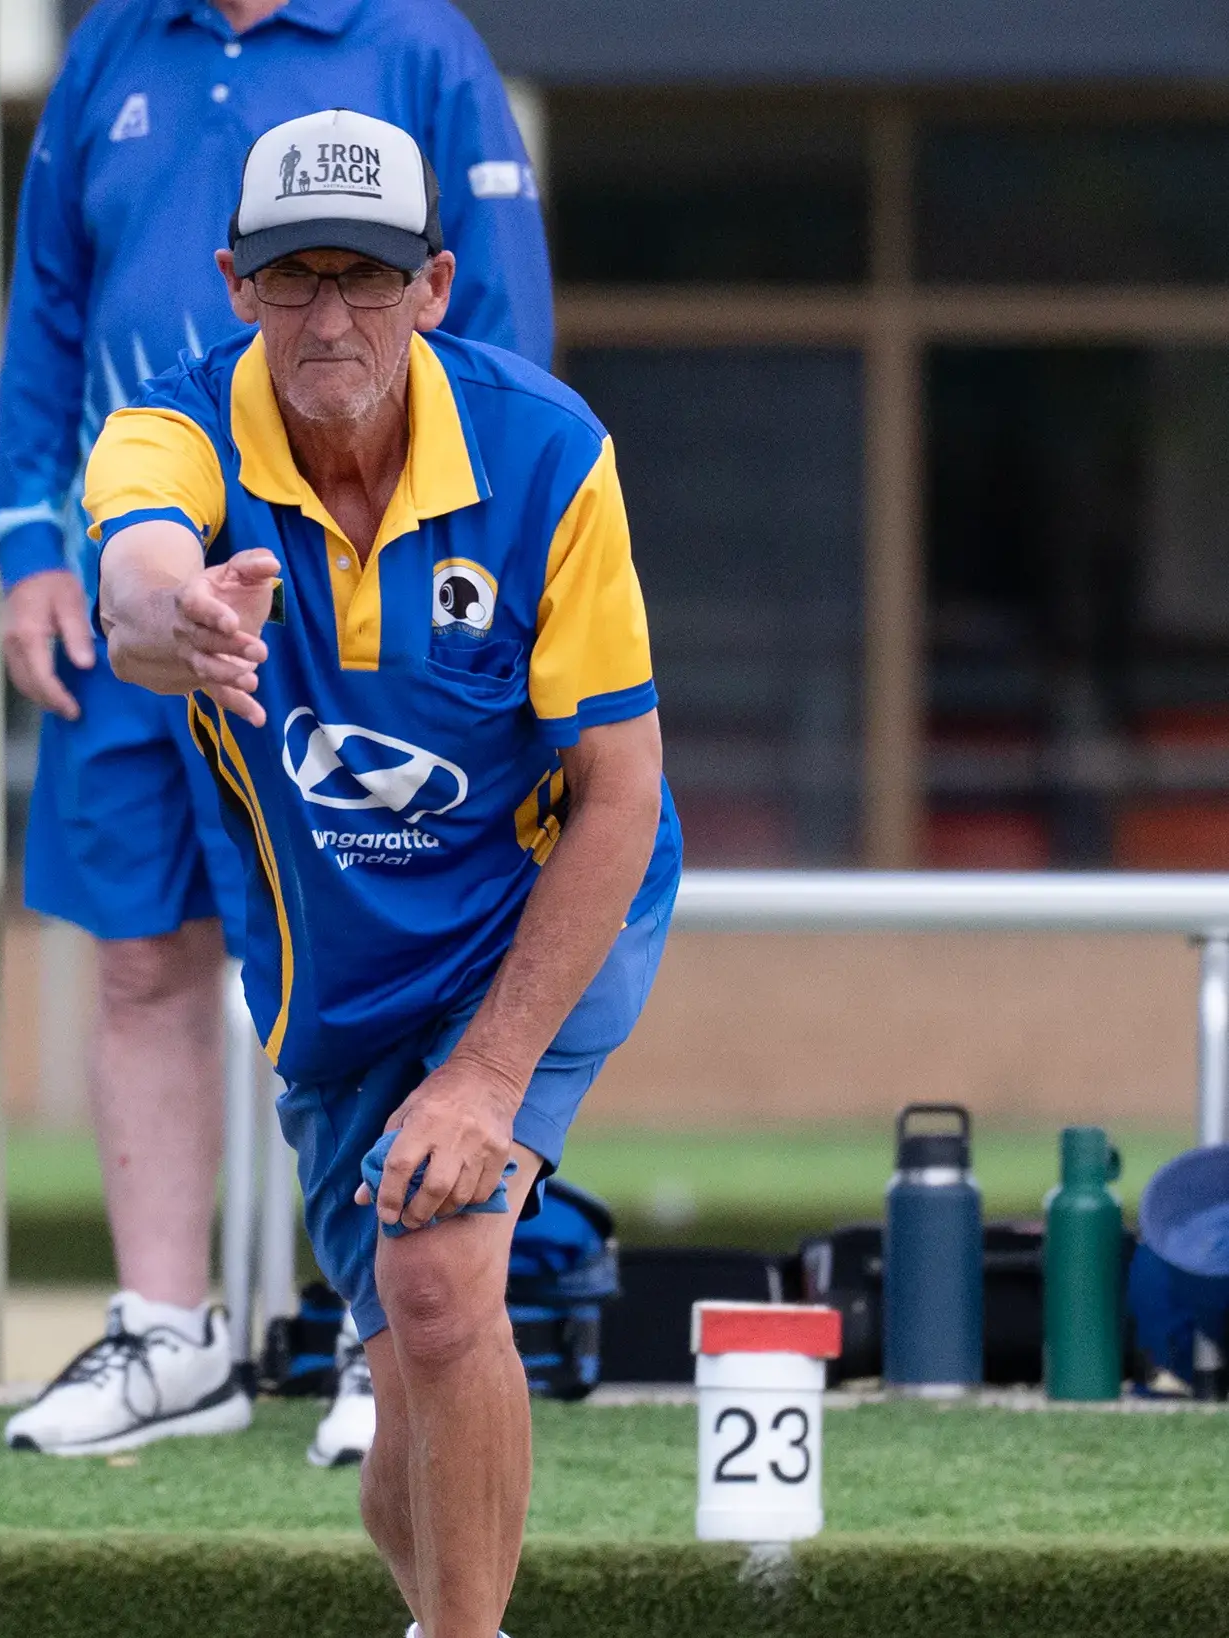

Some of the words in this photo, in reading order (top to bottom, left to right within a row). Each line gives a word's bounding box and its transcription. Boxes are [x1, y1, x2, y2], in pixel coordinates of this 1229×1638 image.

[317, 143, 381, 167] IRON
[314, 163, 381, 187] JACK
[714, 1407, 810, 1484] 23
